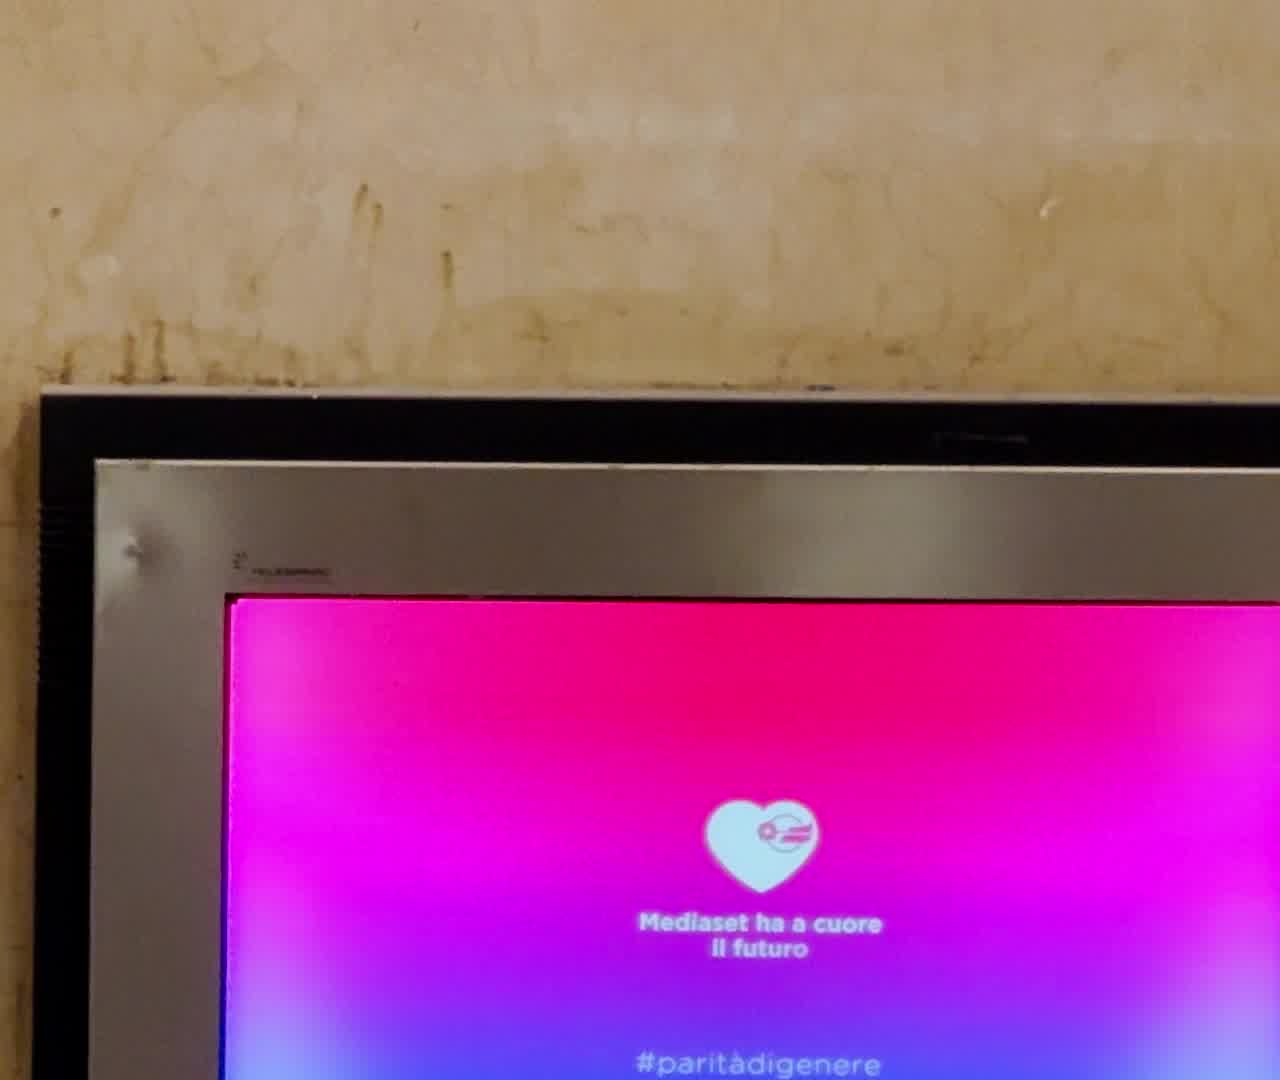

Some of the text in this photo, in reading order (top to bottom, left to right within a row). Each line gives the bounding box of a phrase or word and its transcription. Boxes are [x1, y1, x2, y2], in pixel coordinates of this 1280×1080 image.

[639, 912, 883, 934] Mediaset ha a cuore
[711, 938, 809, 958] il futuro
[636, 1051, 882, 1080] #paritàdigenere
